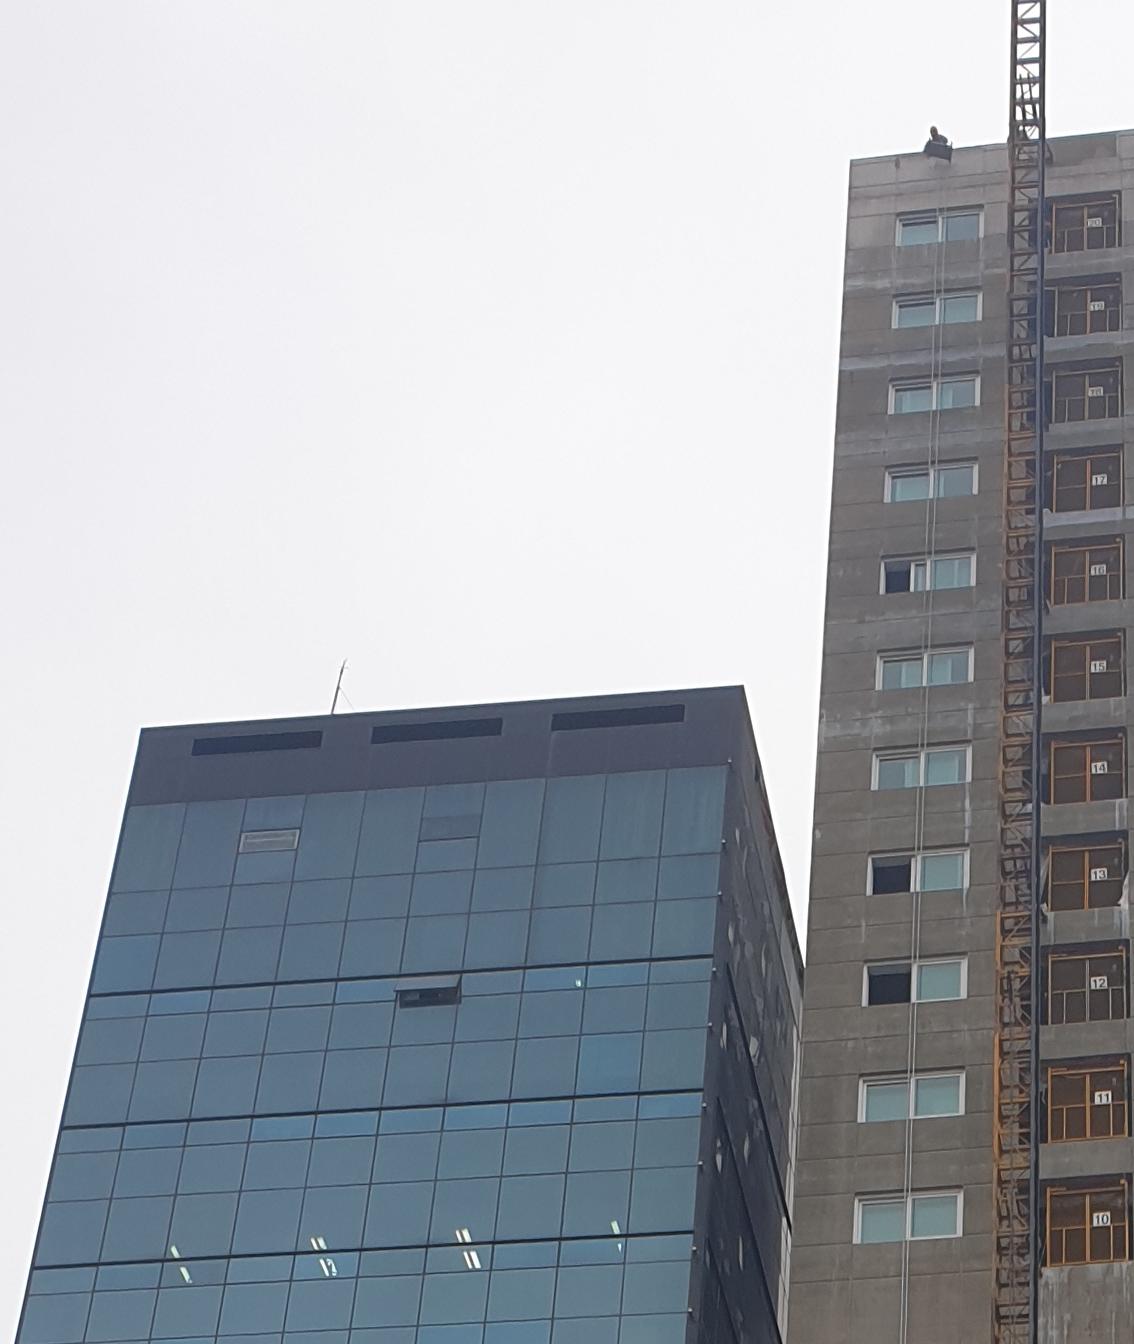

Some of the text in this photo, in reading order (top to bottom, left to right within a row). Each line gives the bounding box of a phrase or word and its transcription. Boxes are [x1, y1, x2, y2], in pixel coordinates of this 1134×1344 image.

[1093, 661, 1105, 672] 15
[1094, 762, 1106, 773] 14
[1093, 868, 1106, 880] 13
[1093, 977, 1105, 989] 12
[1097, 1092, 1110, 1104] 11
[1095, 1213, 1109, 1225] 10
